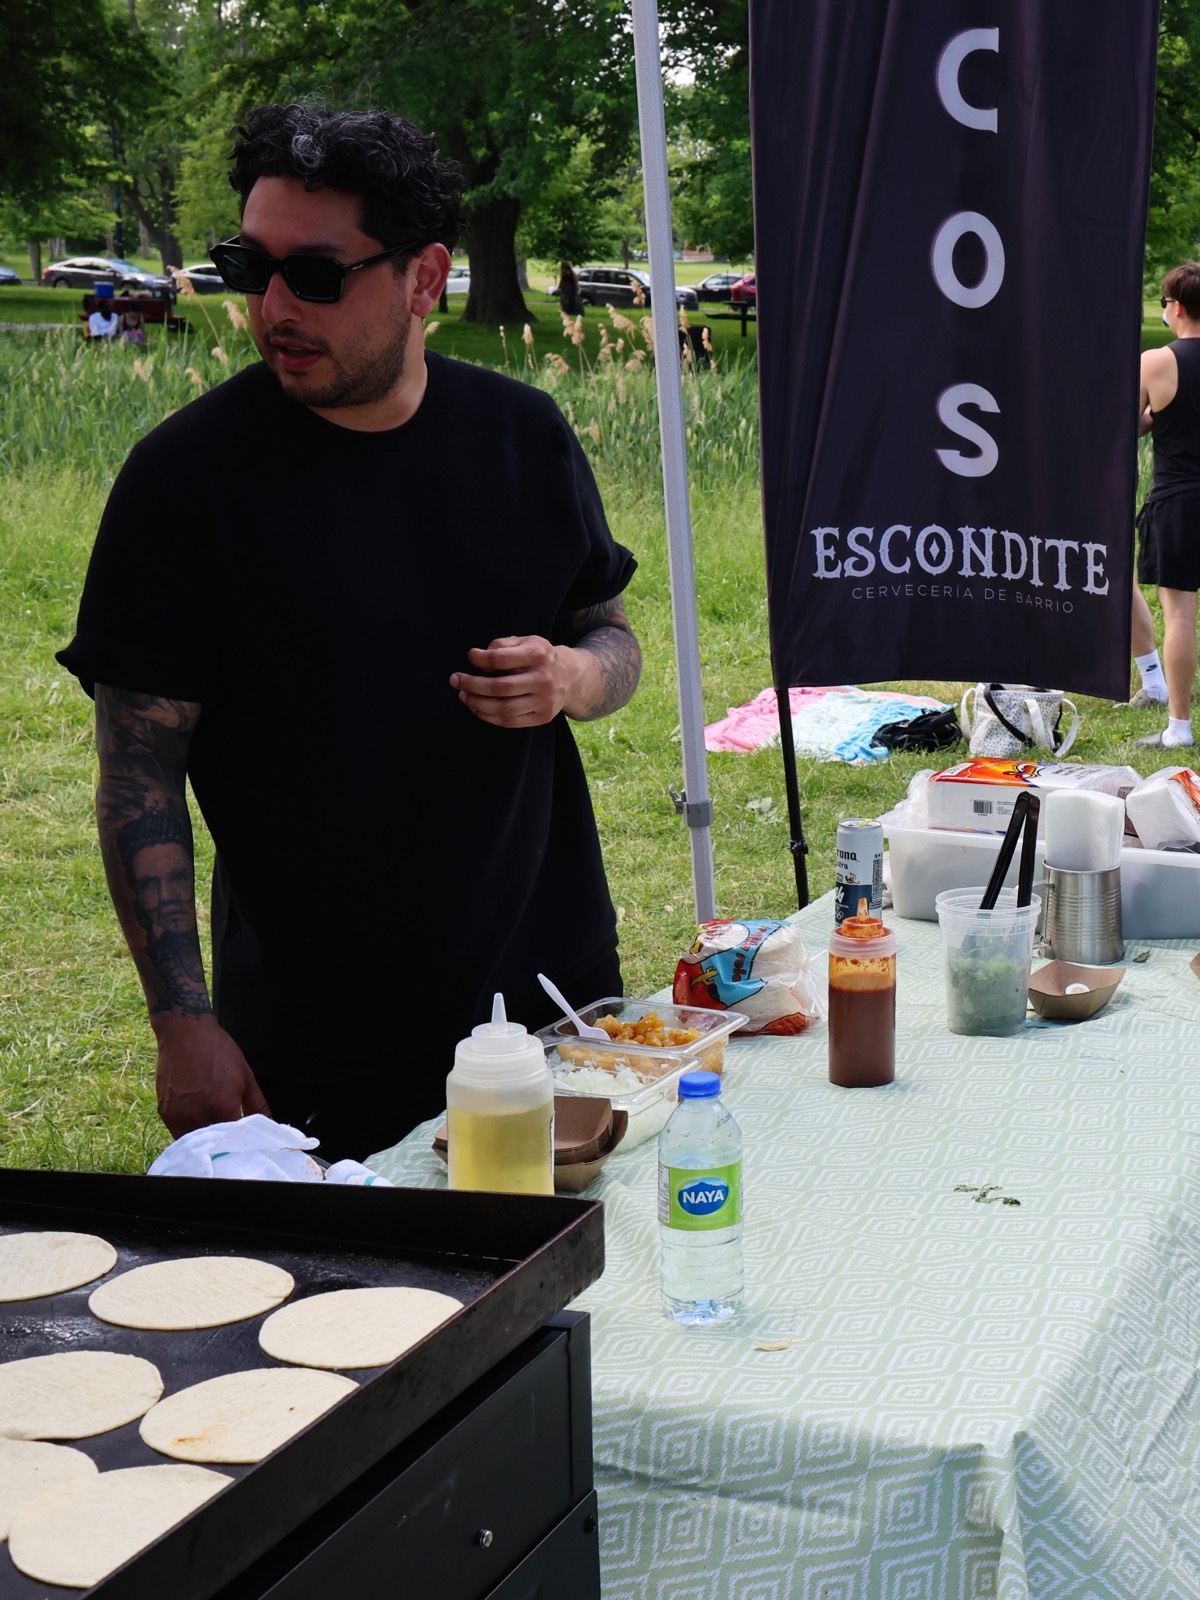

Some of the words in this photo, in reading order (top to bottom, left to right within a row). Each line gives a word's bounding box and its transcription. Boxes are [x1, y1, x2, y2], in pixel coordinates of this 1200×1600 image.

[809, 523, 1110, 596] ESCONDITE
[851, 583, 974, 600] CERVECERÍA
[984, 587, 1007, 601] DE
[1015, 590, 1075, 614] BARRIO
[836, 848, 858, 861] rona
[682, 1188, 725, 1204] NAYA
